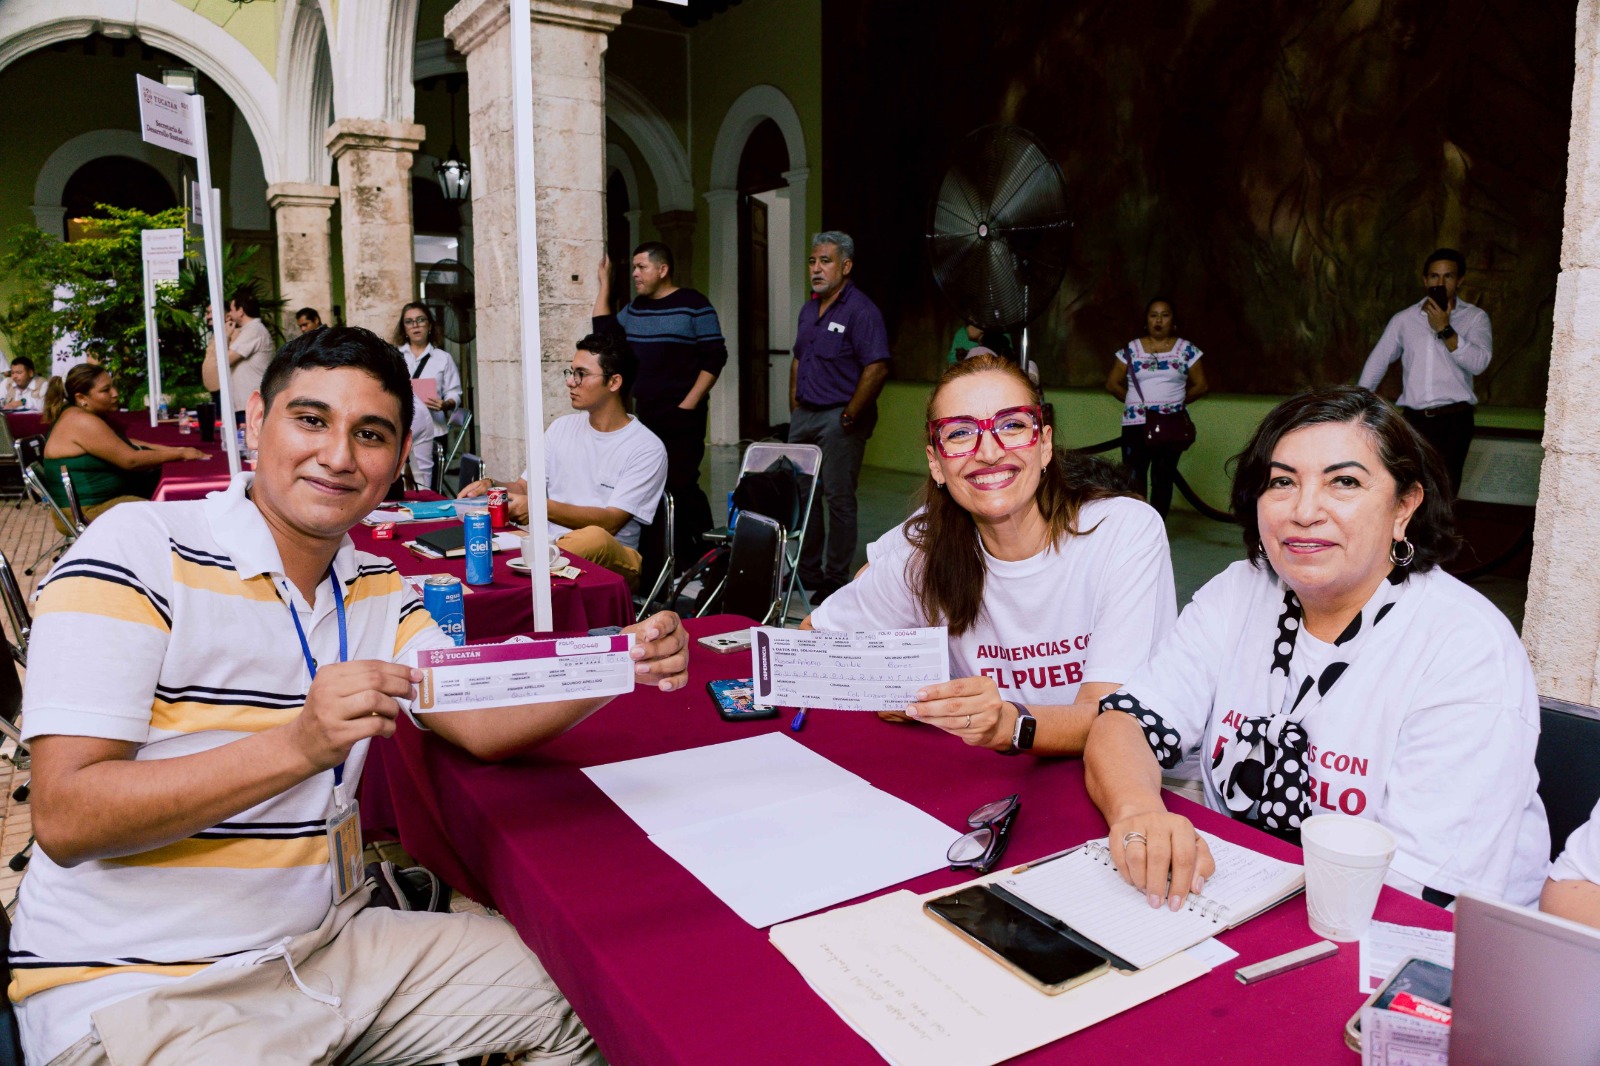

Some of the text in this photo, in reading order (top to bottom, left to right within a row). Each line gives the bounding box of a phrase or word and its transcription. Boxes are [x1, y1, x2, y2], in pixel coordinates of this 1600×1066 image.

[470, 541, 489, 552] ciel
[440, 618, 465, 634] ciel
[445, 651, 481, 660] YUCATÁN
[977, 633, 1092, 661] AUDIENCIAS CO
[1011, 660, 1087, 690] PUEB
[1320, 750, 1369, 777] CON
